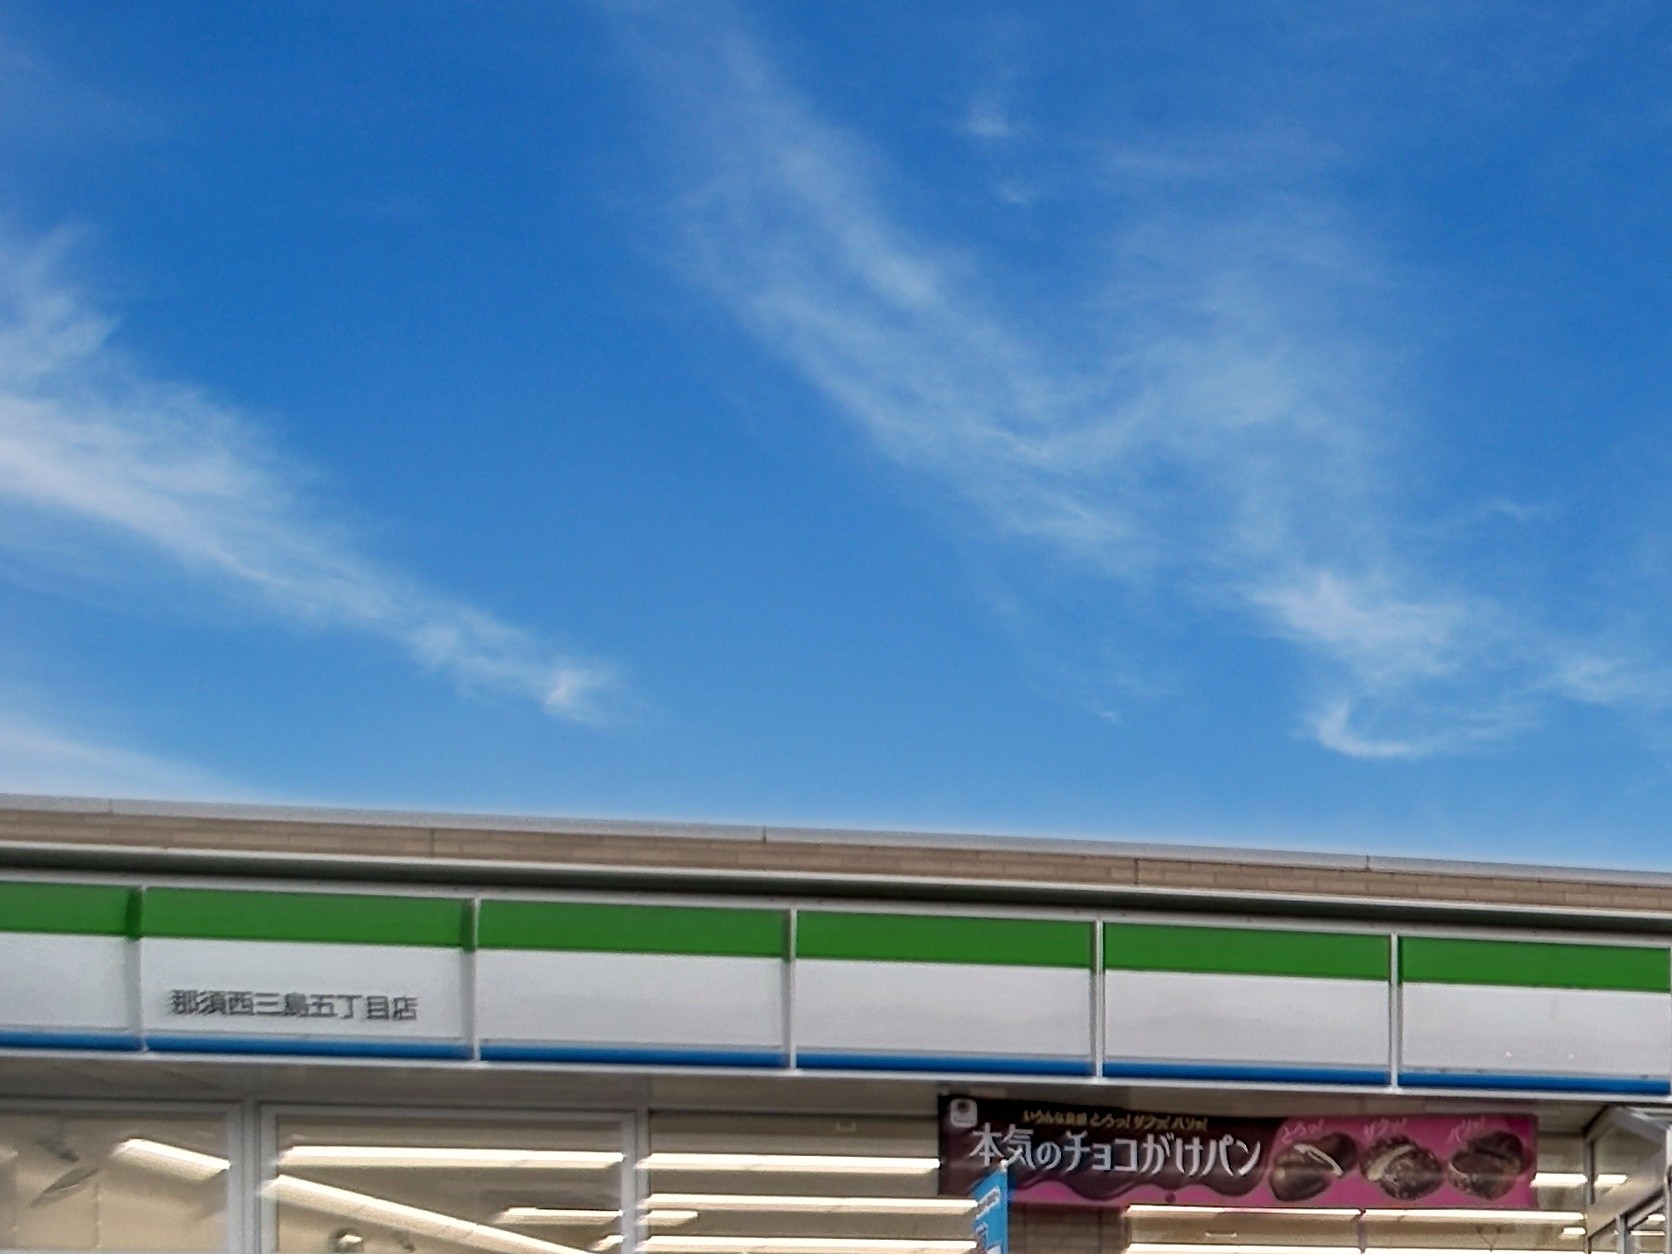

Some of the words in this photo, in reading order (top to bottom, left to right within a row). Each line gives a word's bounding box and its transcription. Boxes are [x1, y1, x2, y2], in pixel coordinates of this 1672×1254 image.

[170, 989, 418, 1021] 那須西三島五丁目店
[968, 1121, 1261, 1178] 本気のチョコがけパン
